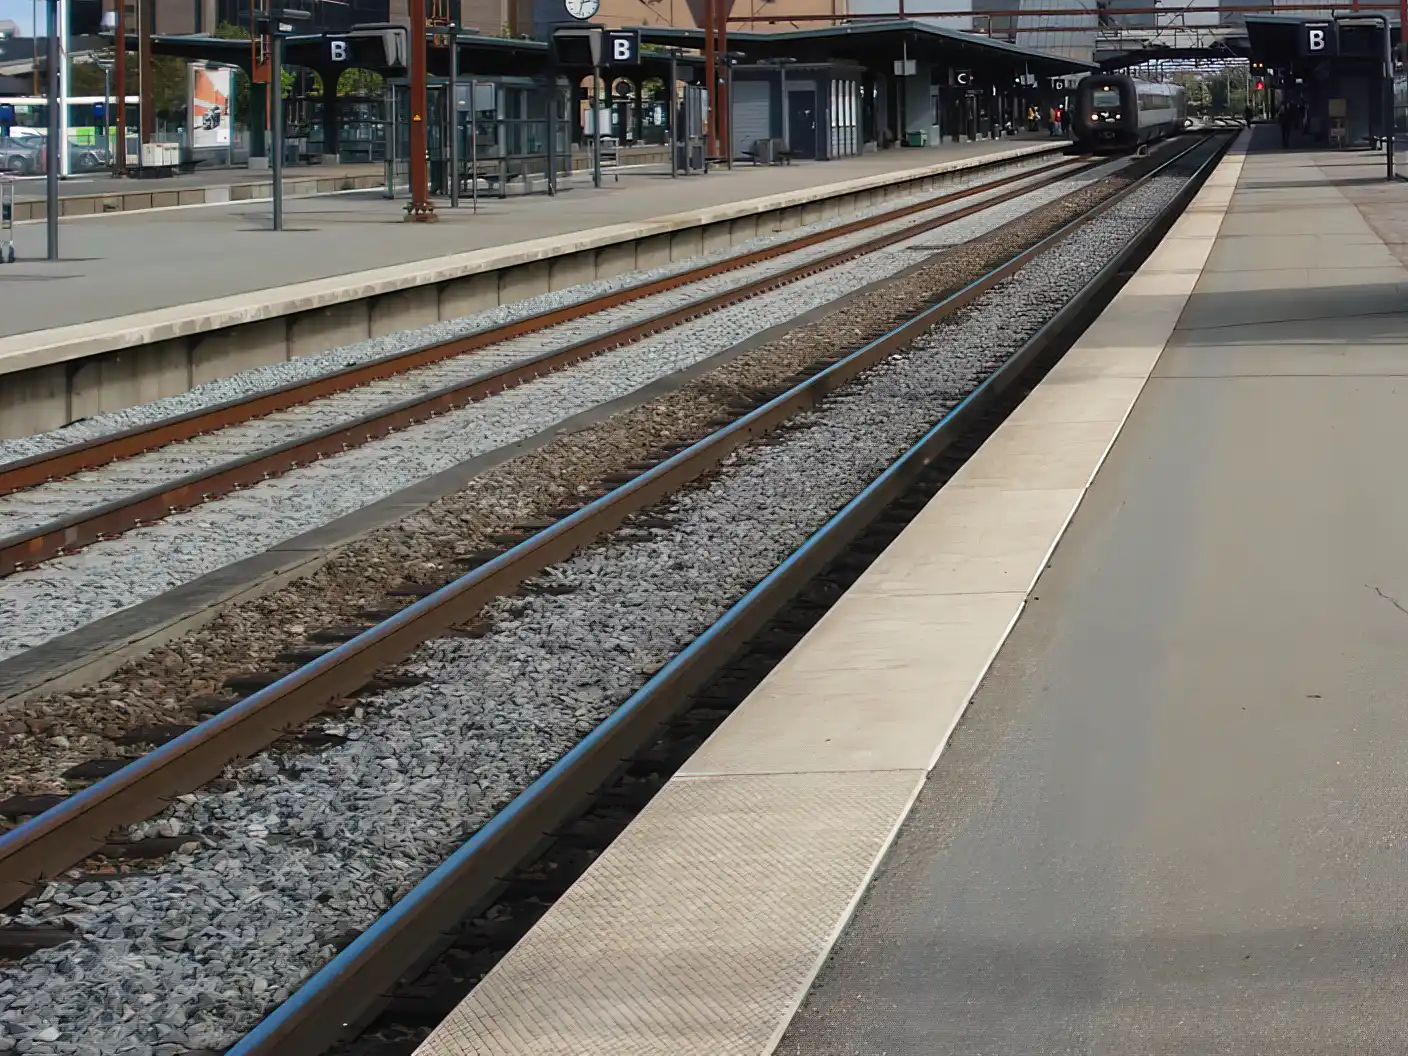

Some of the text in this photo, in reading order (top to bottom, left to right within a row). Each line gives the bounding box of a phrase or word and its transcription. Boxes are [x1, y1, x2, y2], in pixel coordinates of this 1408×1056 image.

[614, 39, 630, 60] B
[1310, 30, 1325, 50] B
[331, 41, 346, 61] B
[957, 73, 967, 84] C
